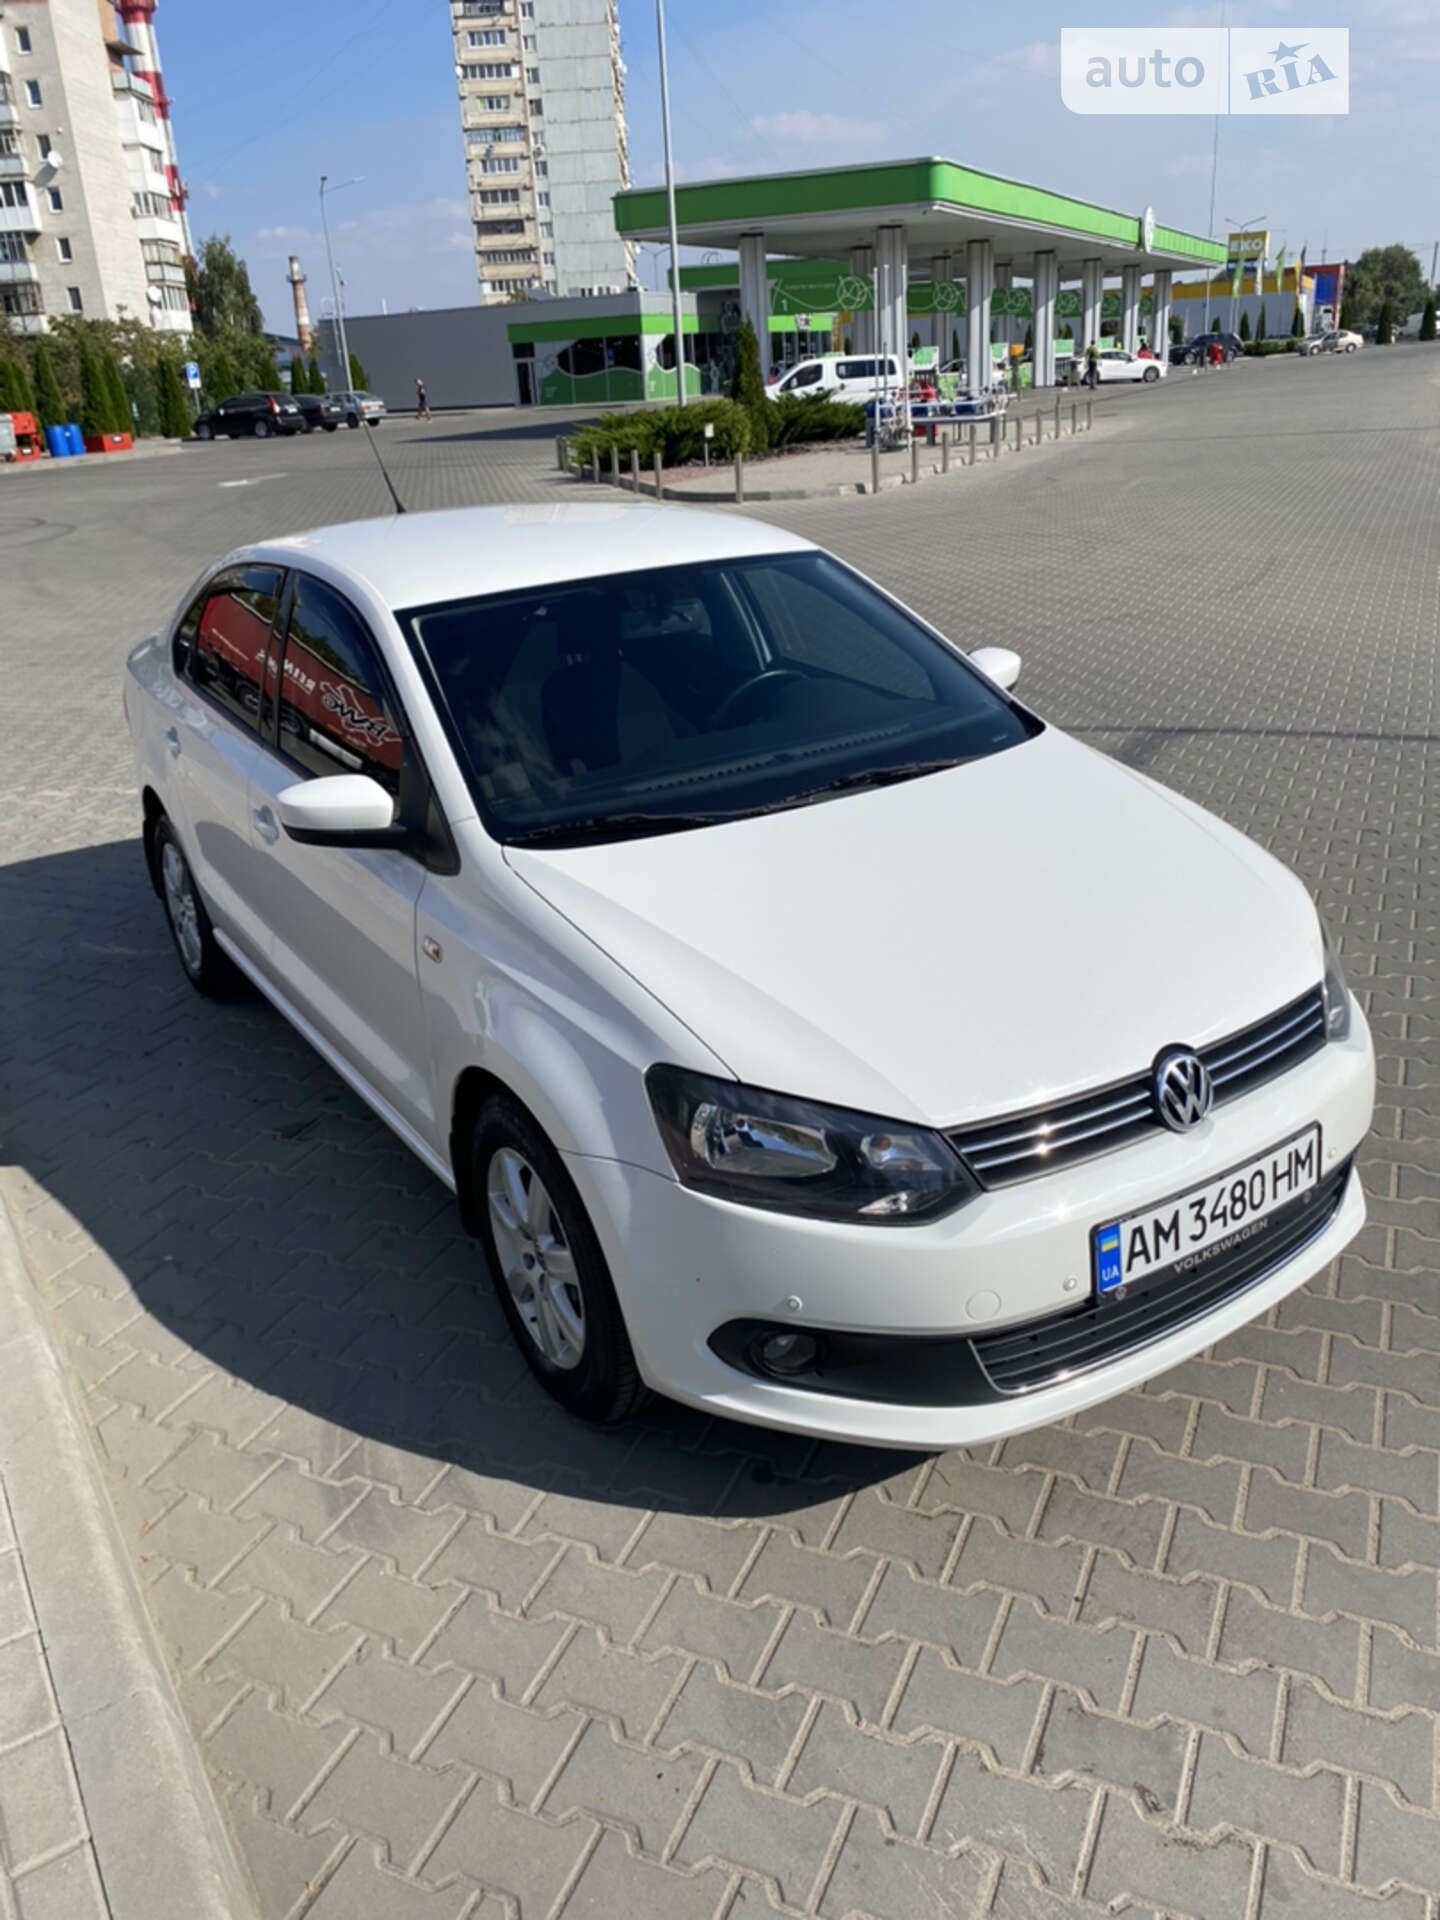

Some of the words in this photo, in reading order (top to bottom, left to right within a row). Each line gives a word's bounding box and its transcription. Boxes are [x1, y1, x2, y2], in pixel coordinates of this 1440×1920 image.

[1126, 1209, 1180, 1273] AM
[1188, 1168, 1266, 1243] 3480
[1271, 1138, 1315, 1201] HM
[1101, 1266, 1120, 1282] UA
[1173, 1217, 1269, 1274] VOLKSWAGEN
